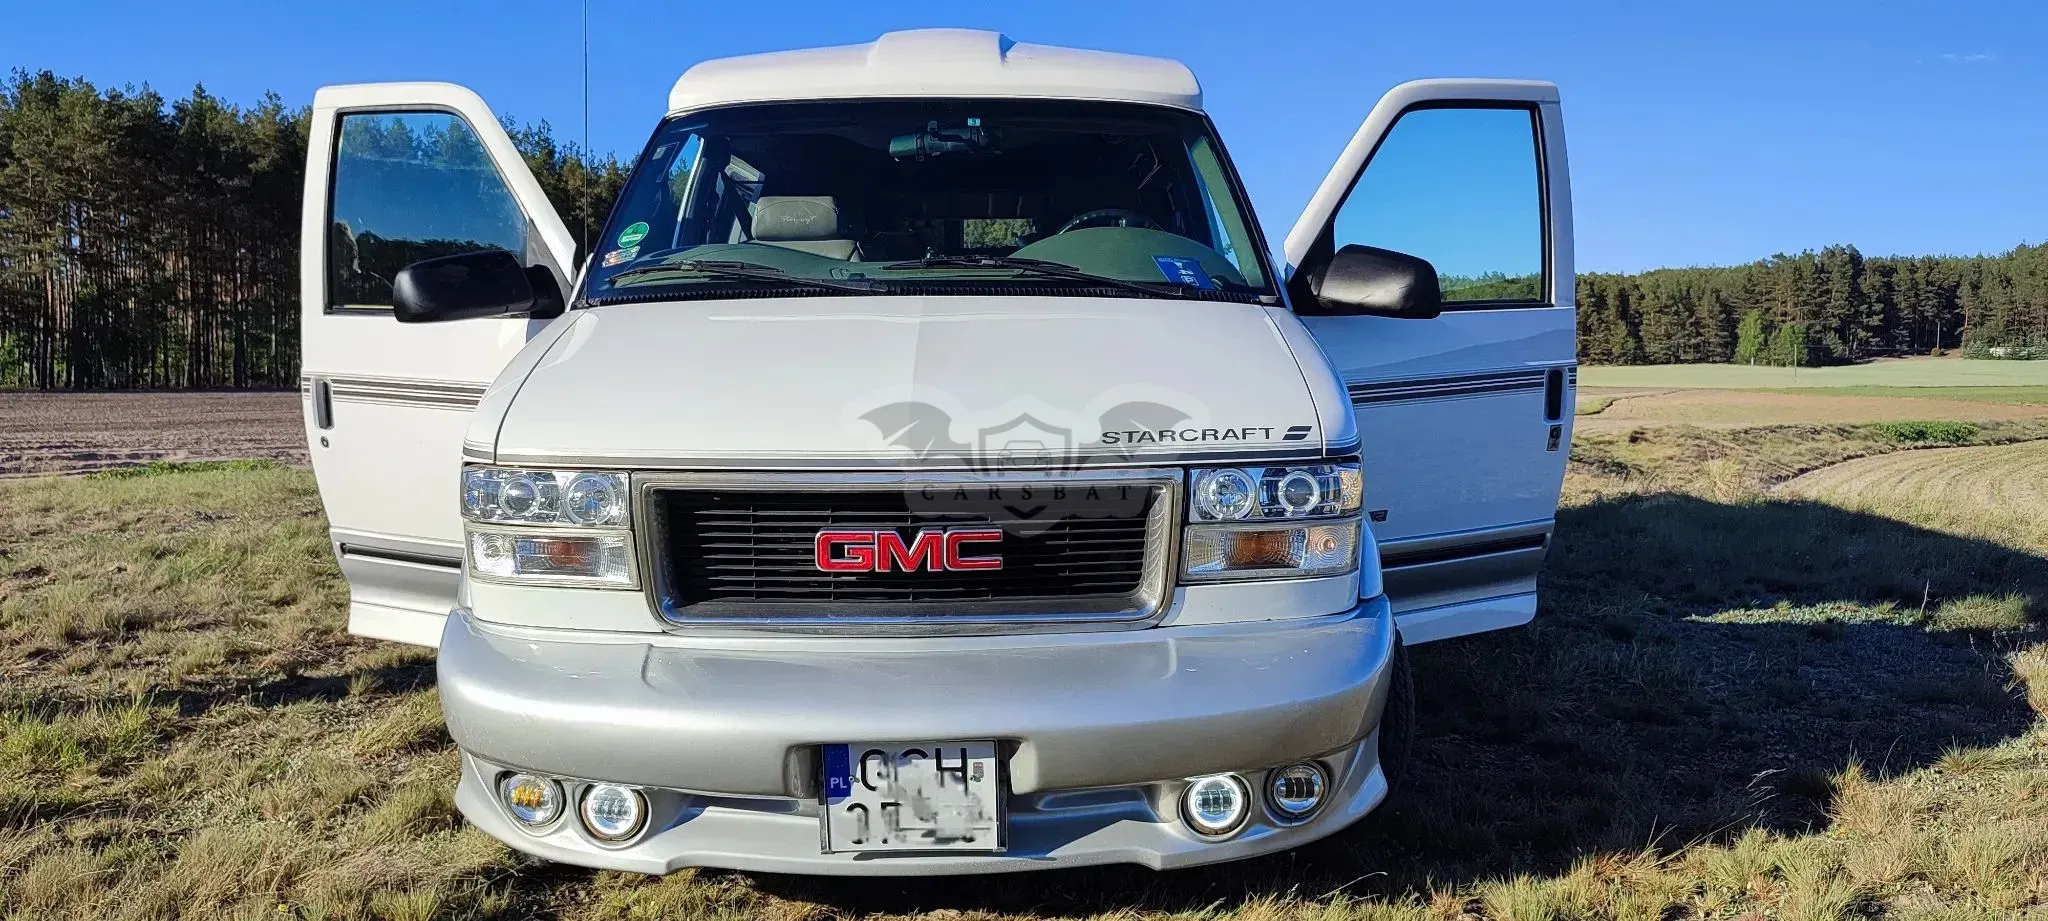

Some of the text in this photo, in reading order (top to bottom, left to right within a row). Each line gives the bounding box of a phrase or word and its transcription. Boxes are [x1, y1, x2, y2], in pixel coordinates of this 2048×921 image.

[1101, 427, 1275, 444] STARCRAFT
[815, 528, 1003, 572] GMC
[830, 777, 848, 789] PL
